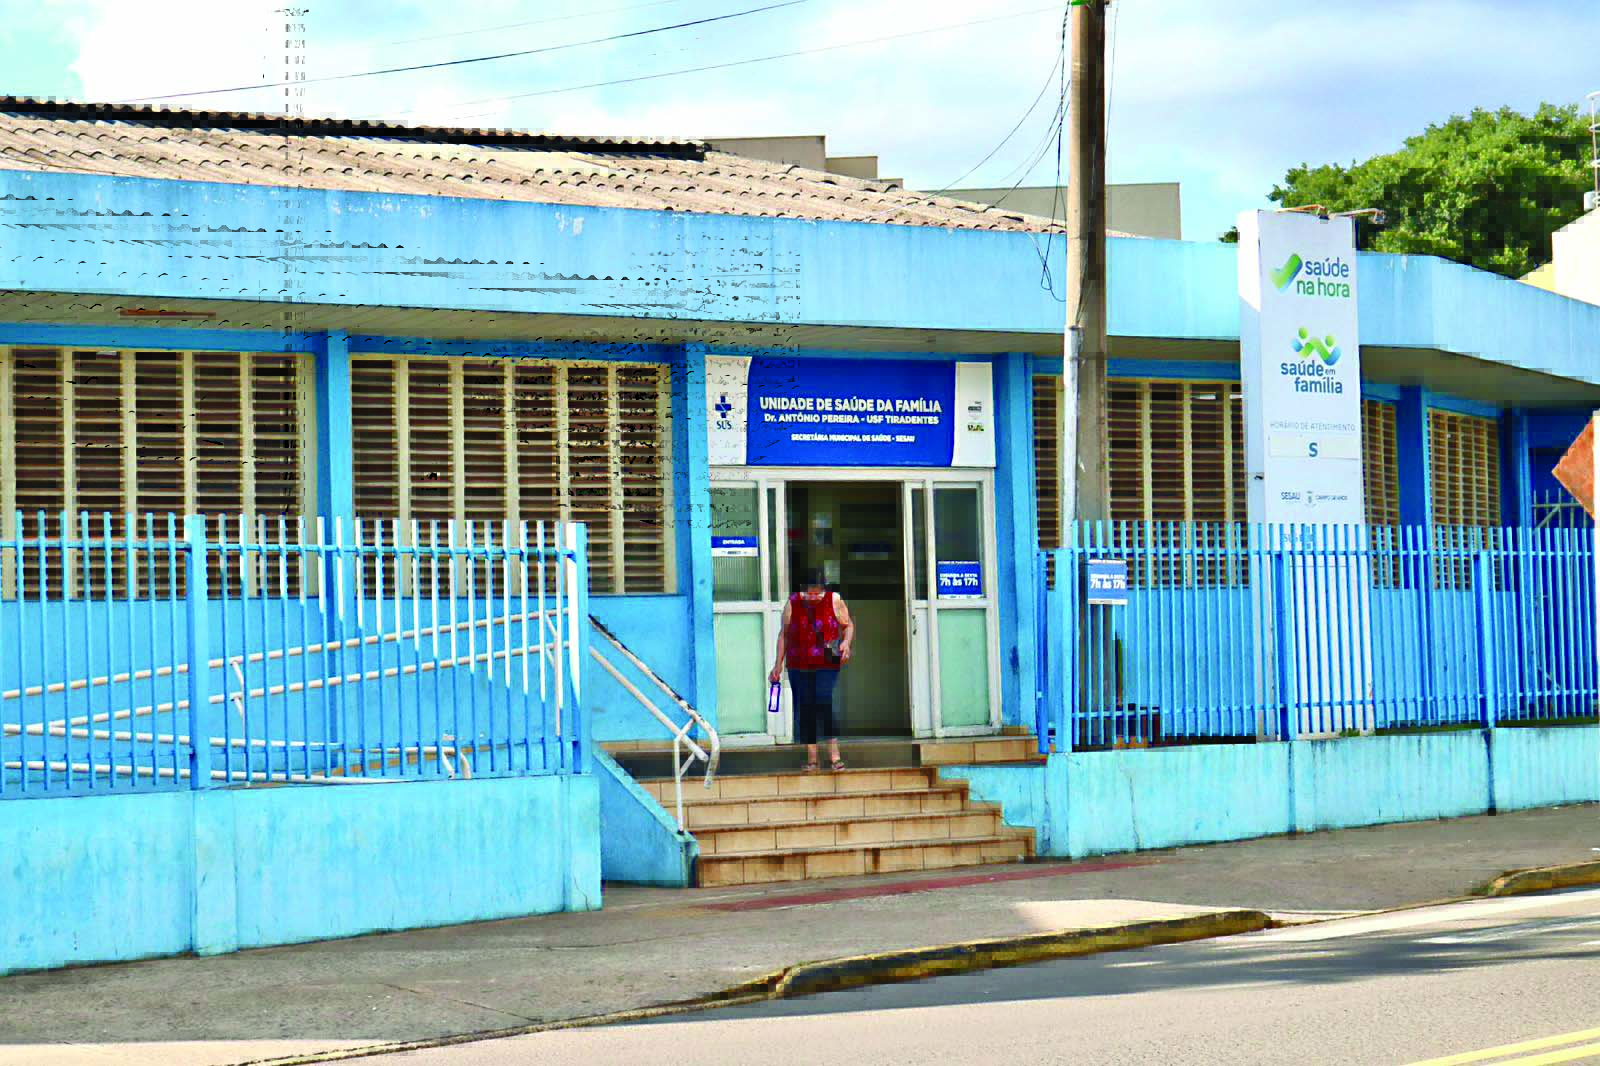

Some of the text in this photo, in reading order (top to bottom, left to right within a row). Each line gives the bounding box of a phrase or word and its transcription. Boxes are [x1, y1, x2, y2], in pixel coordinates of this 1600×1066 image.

[1305, 257, 1349, 278] saúde
[1297, 278, 1350, 298] na hora
[1280, 360, 1336, 377] saúde em
[1295, 376, 1343, 394] família
[760, 396, 942, 413] UNIDADE DE SAÚDE DA FAMÍLIA
[716, 420, 732, 430] SUS
[764, 413, 777, 422] Dr.
[779, 411, 820, 423] ANTÔNIO
[822, 414, 860, 424] PEREIRA
[867, 414, 884, 424] USF
[885, 415, 939, 425] TIRADENTES
[1308, 442, 1318, 458] S
[940, 577, 951, 586] 7h
[964, 577, 978, 586] 17h
[1090, 578, 1101, 589] 7h
[1113, 579, 1126, 589] 17h
